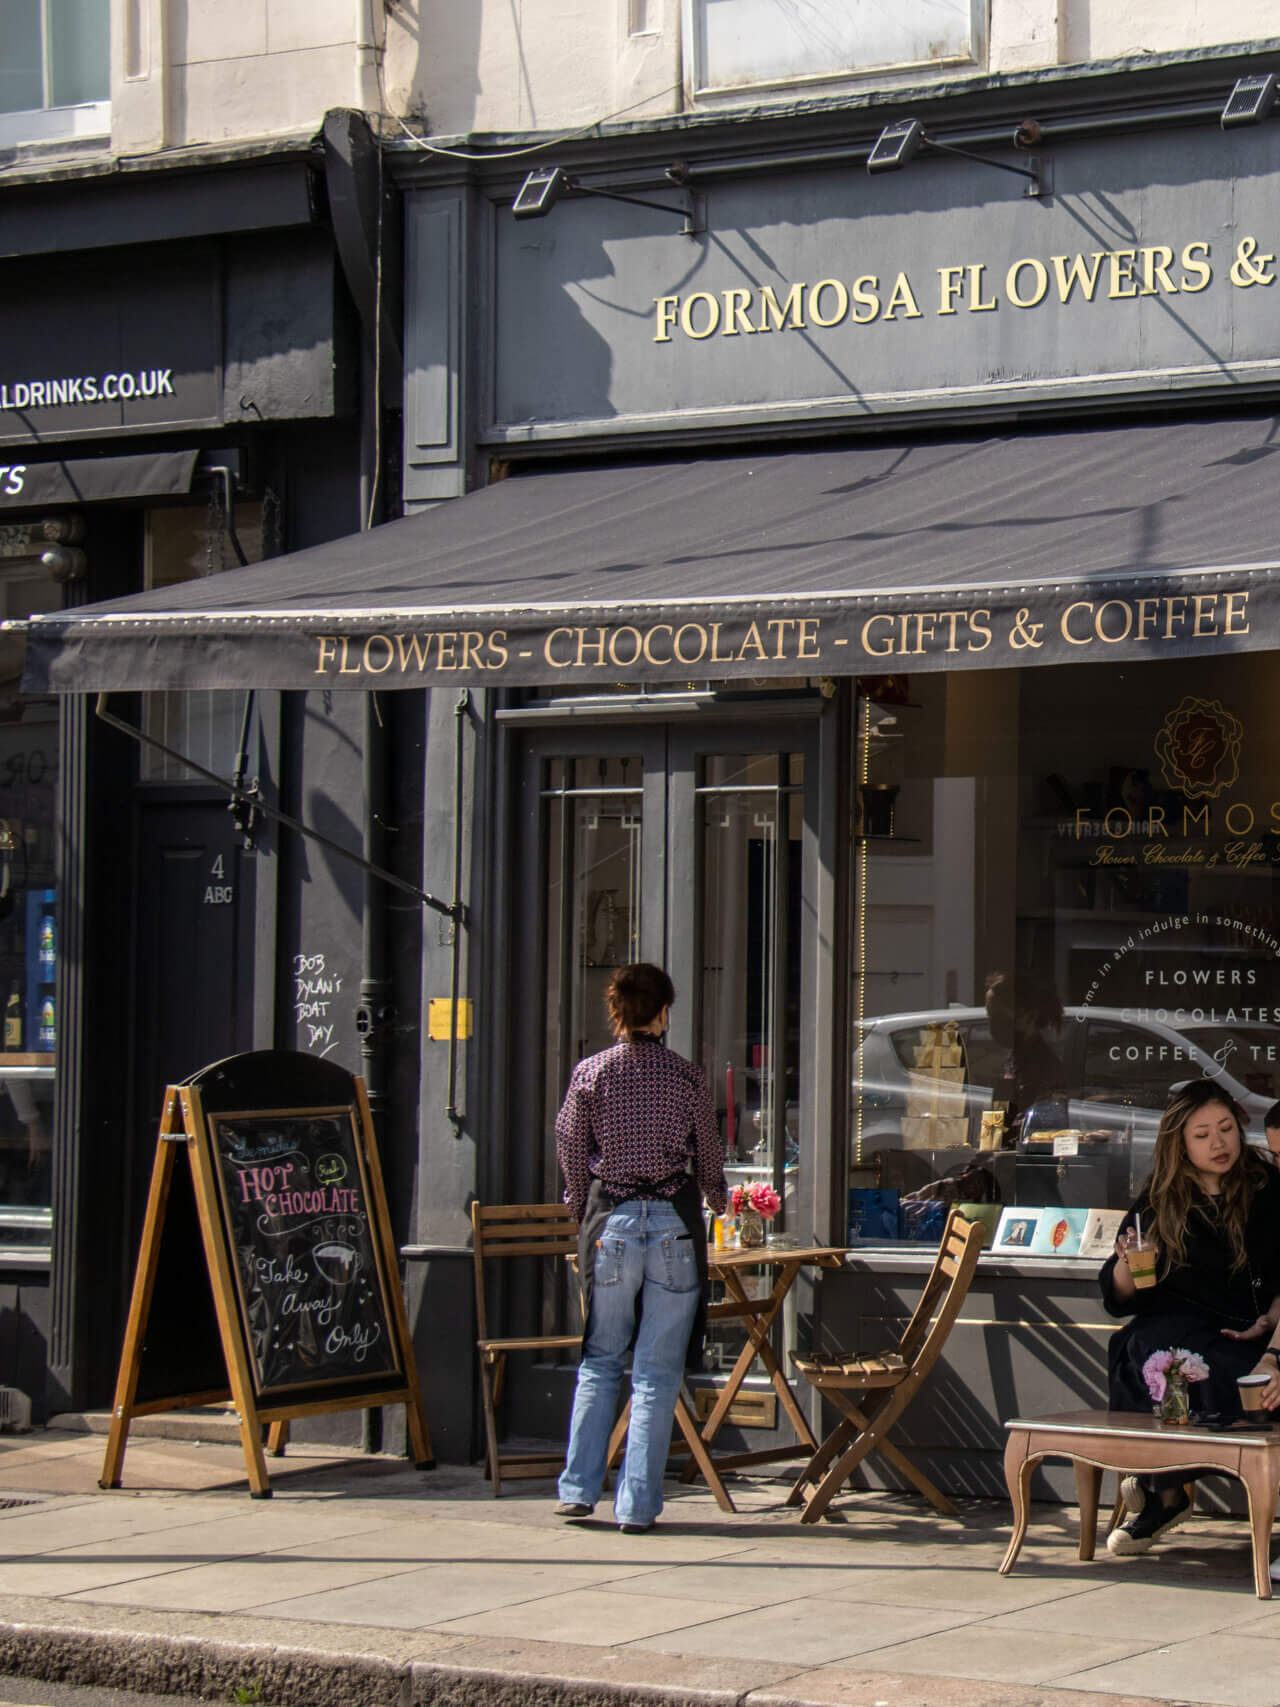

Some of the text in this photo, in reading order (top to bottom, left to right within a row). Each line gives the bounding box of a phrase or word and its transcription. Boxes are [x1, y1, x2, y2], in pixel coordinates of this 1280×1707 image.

[653, 270, 922, 342] FORMOSA
[937, 242, 1211, 315] FLOWERS
[1229, 236, 1275, 288] &
[0, 369, 173, 408] LDRINKS.CO.UK
[315, 630, 508, 674] FLOWERS
[543, 618, 821, 668] CHOCOLATE
[861, 609, 993, 657] GIFTS
[1008, 607, 1044, 650] &
[1061, 591, 1250, 644] COFFEE
[210, 853, 225, 879] 4
[1143, 843, 1206, 865] Chocolate
[1224, 841, 1266, 870] Coffee
[204, 886, 233, 904] ABC
[1101, 962, 1112, 977] in
[1114, 937, 1135, 960] and
[1139, 914, 1189, 940] indulge
[1196, 912, 1209, 924] in
[293, 953, 325, 976] BOB
[1145, 969, 1257, 985] FLOWERS
[307, 1024, 334, 1048] DAY
[1109, 1046, 1199, 1062] COFFEE
[1202, 1039, 1238, 1080] &
[237, 1163, 295, 1203] HOT
[265, 1187, 360, 1218] CHOCOLATE
[256, 1254, 308, 1284] Take
[282, 1292, 342, 1325] Away
[325, 1321, 381, 1362] Only
